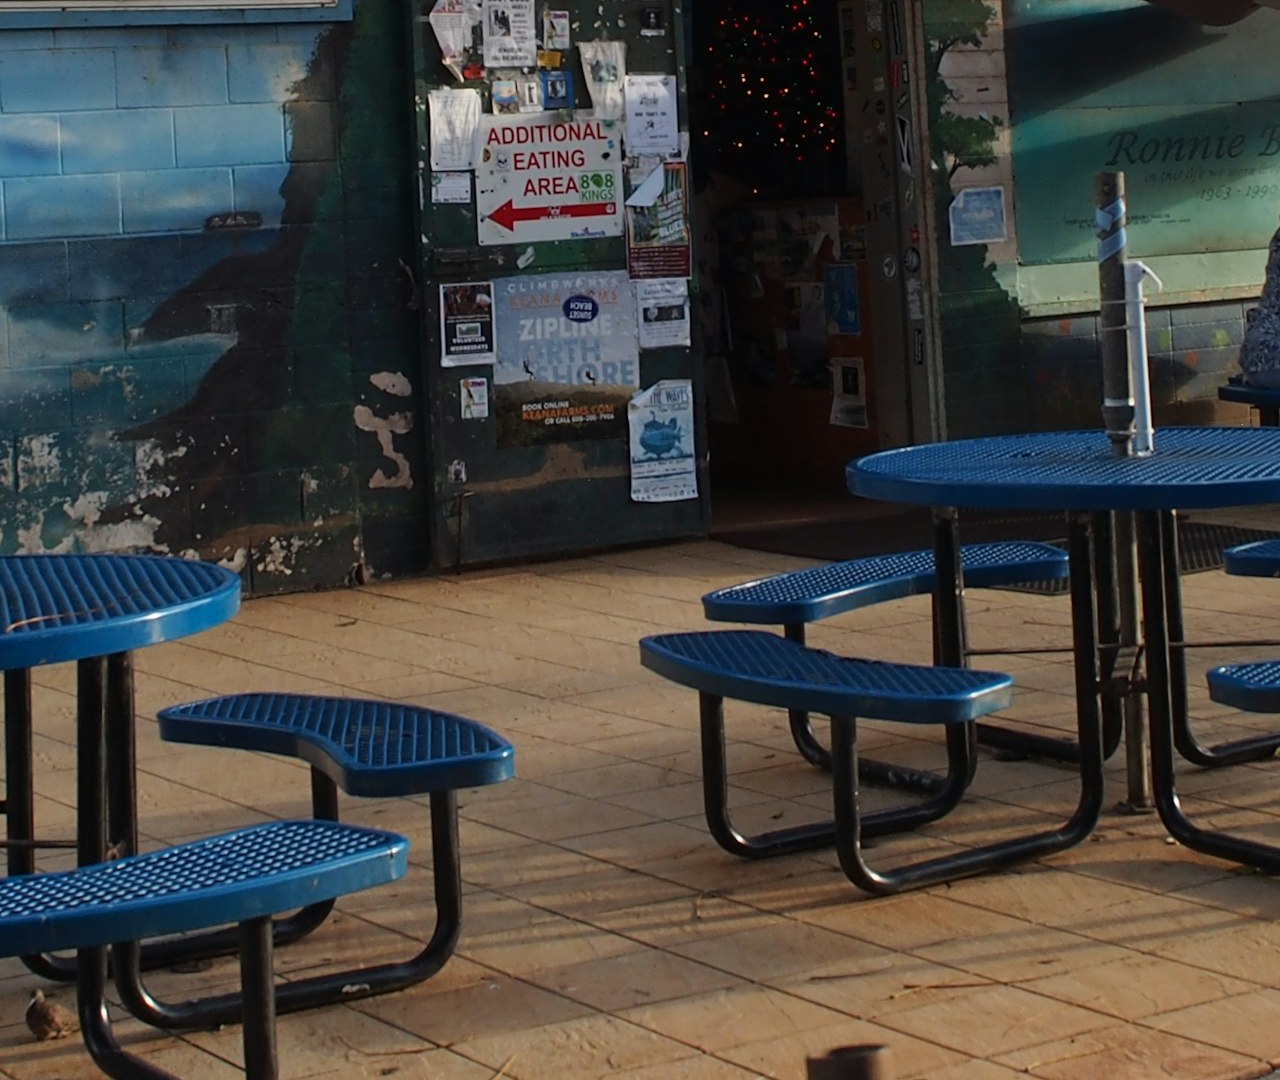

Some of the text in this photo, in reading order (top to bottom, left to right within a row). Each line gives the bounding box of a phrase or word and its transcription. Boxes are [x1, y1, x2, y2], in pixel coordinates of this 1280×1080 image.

[487, 122, 608, 145] ADDITIONAL
[1105, 131, 1245, 167] Ronnie
[513, 149, 585, 171] EATING
[1160, 170, 1183, 183] this
[1185, 168, 1204, 184] life
[523, 176, 579, 196] AREA
[1199, 184, 1231, 202] 1963
[581, 188, 614, 201] KINGS
[570, 301, 593, 311] BEACH
[569, 311, 593, 320] SUNSET
[519, 314, 612, 341] ZIPLINE
[450, 343, 489, 352] WEDNESDAYS
[452, 336, 486, 344] VOLUNTEER
[535, 360, 635, 385] SHORE
[666, 387, 690, 403] WAVES
[522, 400, 570, 412] BOOK ONLINE
[522, 404, 615, 420] KEANAFARMS.COM
[555, 416, 570, 424] CALL
